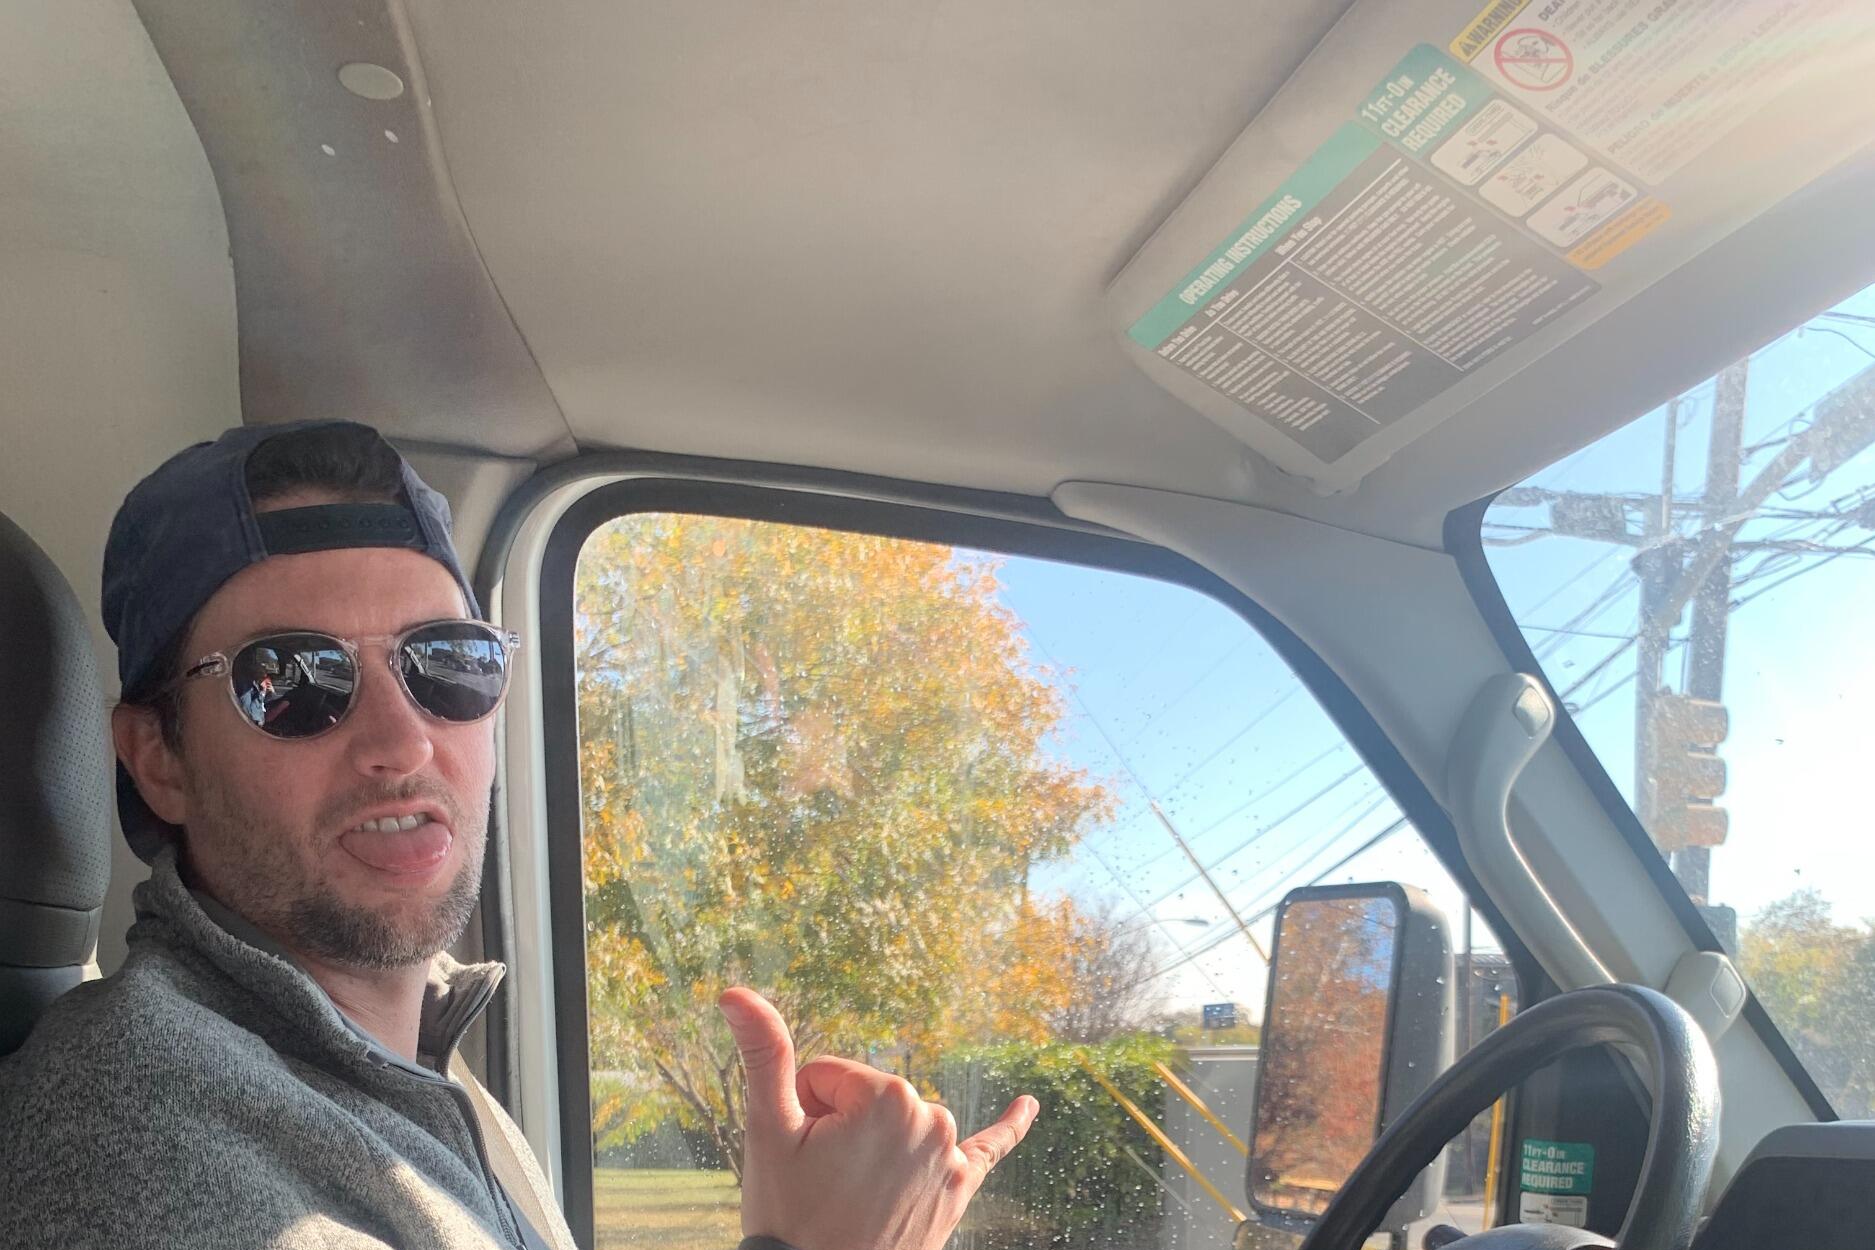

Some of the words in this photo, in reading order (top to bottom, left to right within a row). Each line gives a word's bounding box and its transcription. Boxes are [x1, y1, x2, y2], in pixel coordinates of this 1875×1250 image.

[1538, 0, 1565, 21] DEA
[1381, 67, 1456, 137] CLEARANCE
[1401, 93, 1466, 152] REQUIRED
[1179, 257, 1235, 305] OPERATING
[1225, 195, 1302, 264] INSTRUCTIONS
[1521, 1172, 1573, 1189] REQUIRED
[1522, 1158, 1585, 1175] CLEARANCE
